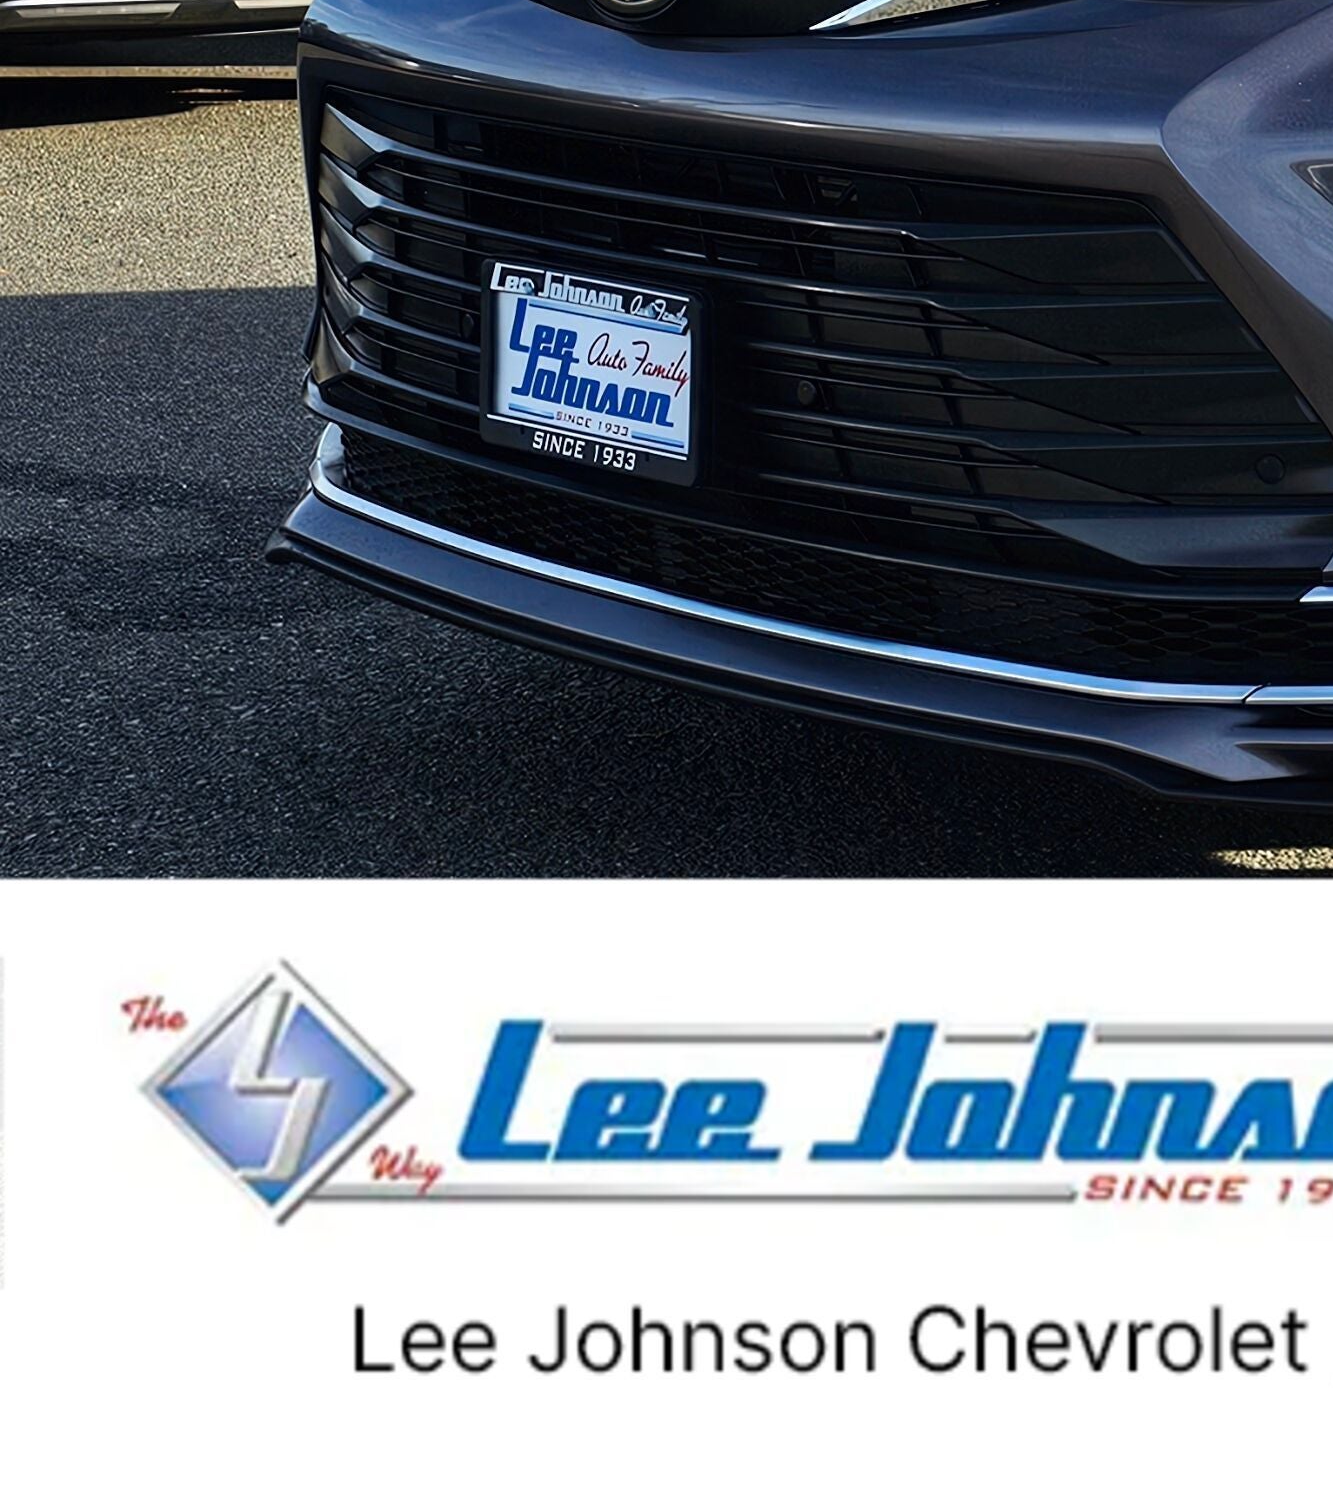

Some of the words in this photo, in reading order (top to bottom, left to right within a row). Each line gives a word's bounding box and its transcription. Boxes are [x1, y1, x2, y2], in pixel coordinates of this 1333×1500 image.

[537, 270, 626, 312] Johnson
[509, 297, 580, 364] Lee
[587, 332, 627, 371] Auto
[632, 339, 690, 398] Family
[510, 348, 675, 428] Johnson
[555, 410, 593, 430] SINCE
[598, 420, 630, 438] 1933
[532, 431, 586, 460] SINCE
[593, 444, 637, 472] 1933
